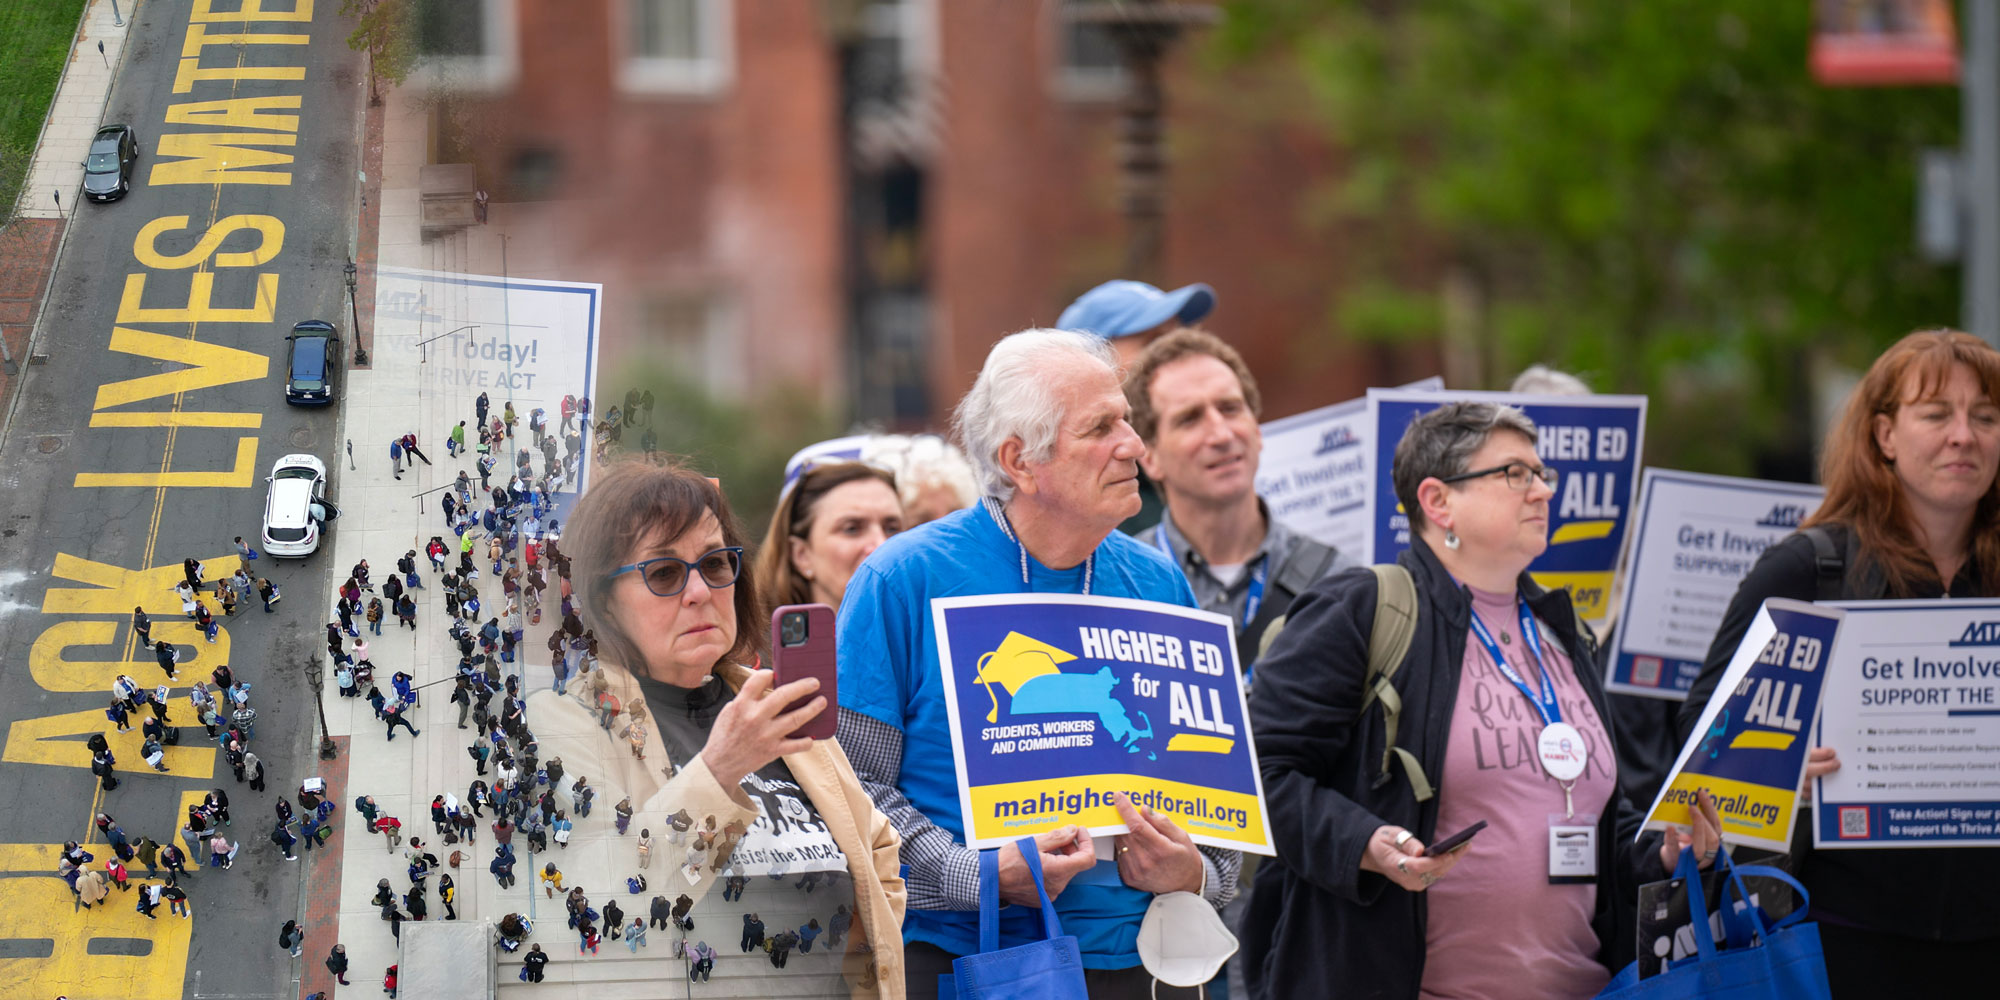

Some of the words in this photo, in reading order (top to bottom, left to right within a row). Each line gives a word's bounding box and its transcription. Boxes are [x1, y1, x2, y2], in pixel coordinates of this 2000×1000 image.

[74, 214, 286, 487] LIVES
[450, 333, 538, 368] Today!
[494, 371, 537, 390] ACT
[1537, 425, 1591, 462] HER
[1595, 427, 1629, 461] ED
[1559, 471, 1620, 519] ALL
[1677, 525, 1715, 549] Get
[1079, 626, 1187, 670] HIGHER
[1188, 639, 1224, 677] ED
[1789, 635, 1822, 672] ED
[1861, 657, 1904, 680] Get
[1132, 672, 1160, 698] for
[1169, 681, 1235, 736] ALL
[1744, 677, 1802, 732] ALL
[1861, 687, 1951, 706] SUPPORT
[1957, 686, 1995, 704] THE
[982, 723, 1041, 741] STUDENTS,
[1042, 720, 1095, 735] WORKERS
[991, 740, 1016, 755] AND
[1018, 734, 1094, 752] COMMUNITIES
[1888, 808, 1912, 820] Take
[1914, 808, 1949, 820] Action!
[1950, 807, 1973, 822] Sign
[1975, 810, 1993, 819] our
[1889, 825, 1900, 835] to
[1901, 825, 1940, 837] support
[1942, 824, 1958, 834] the
[1959, 822, 1993, 834] Thrive
[769, 847, 797, 863] the
